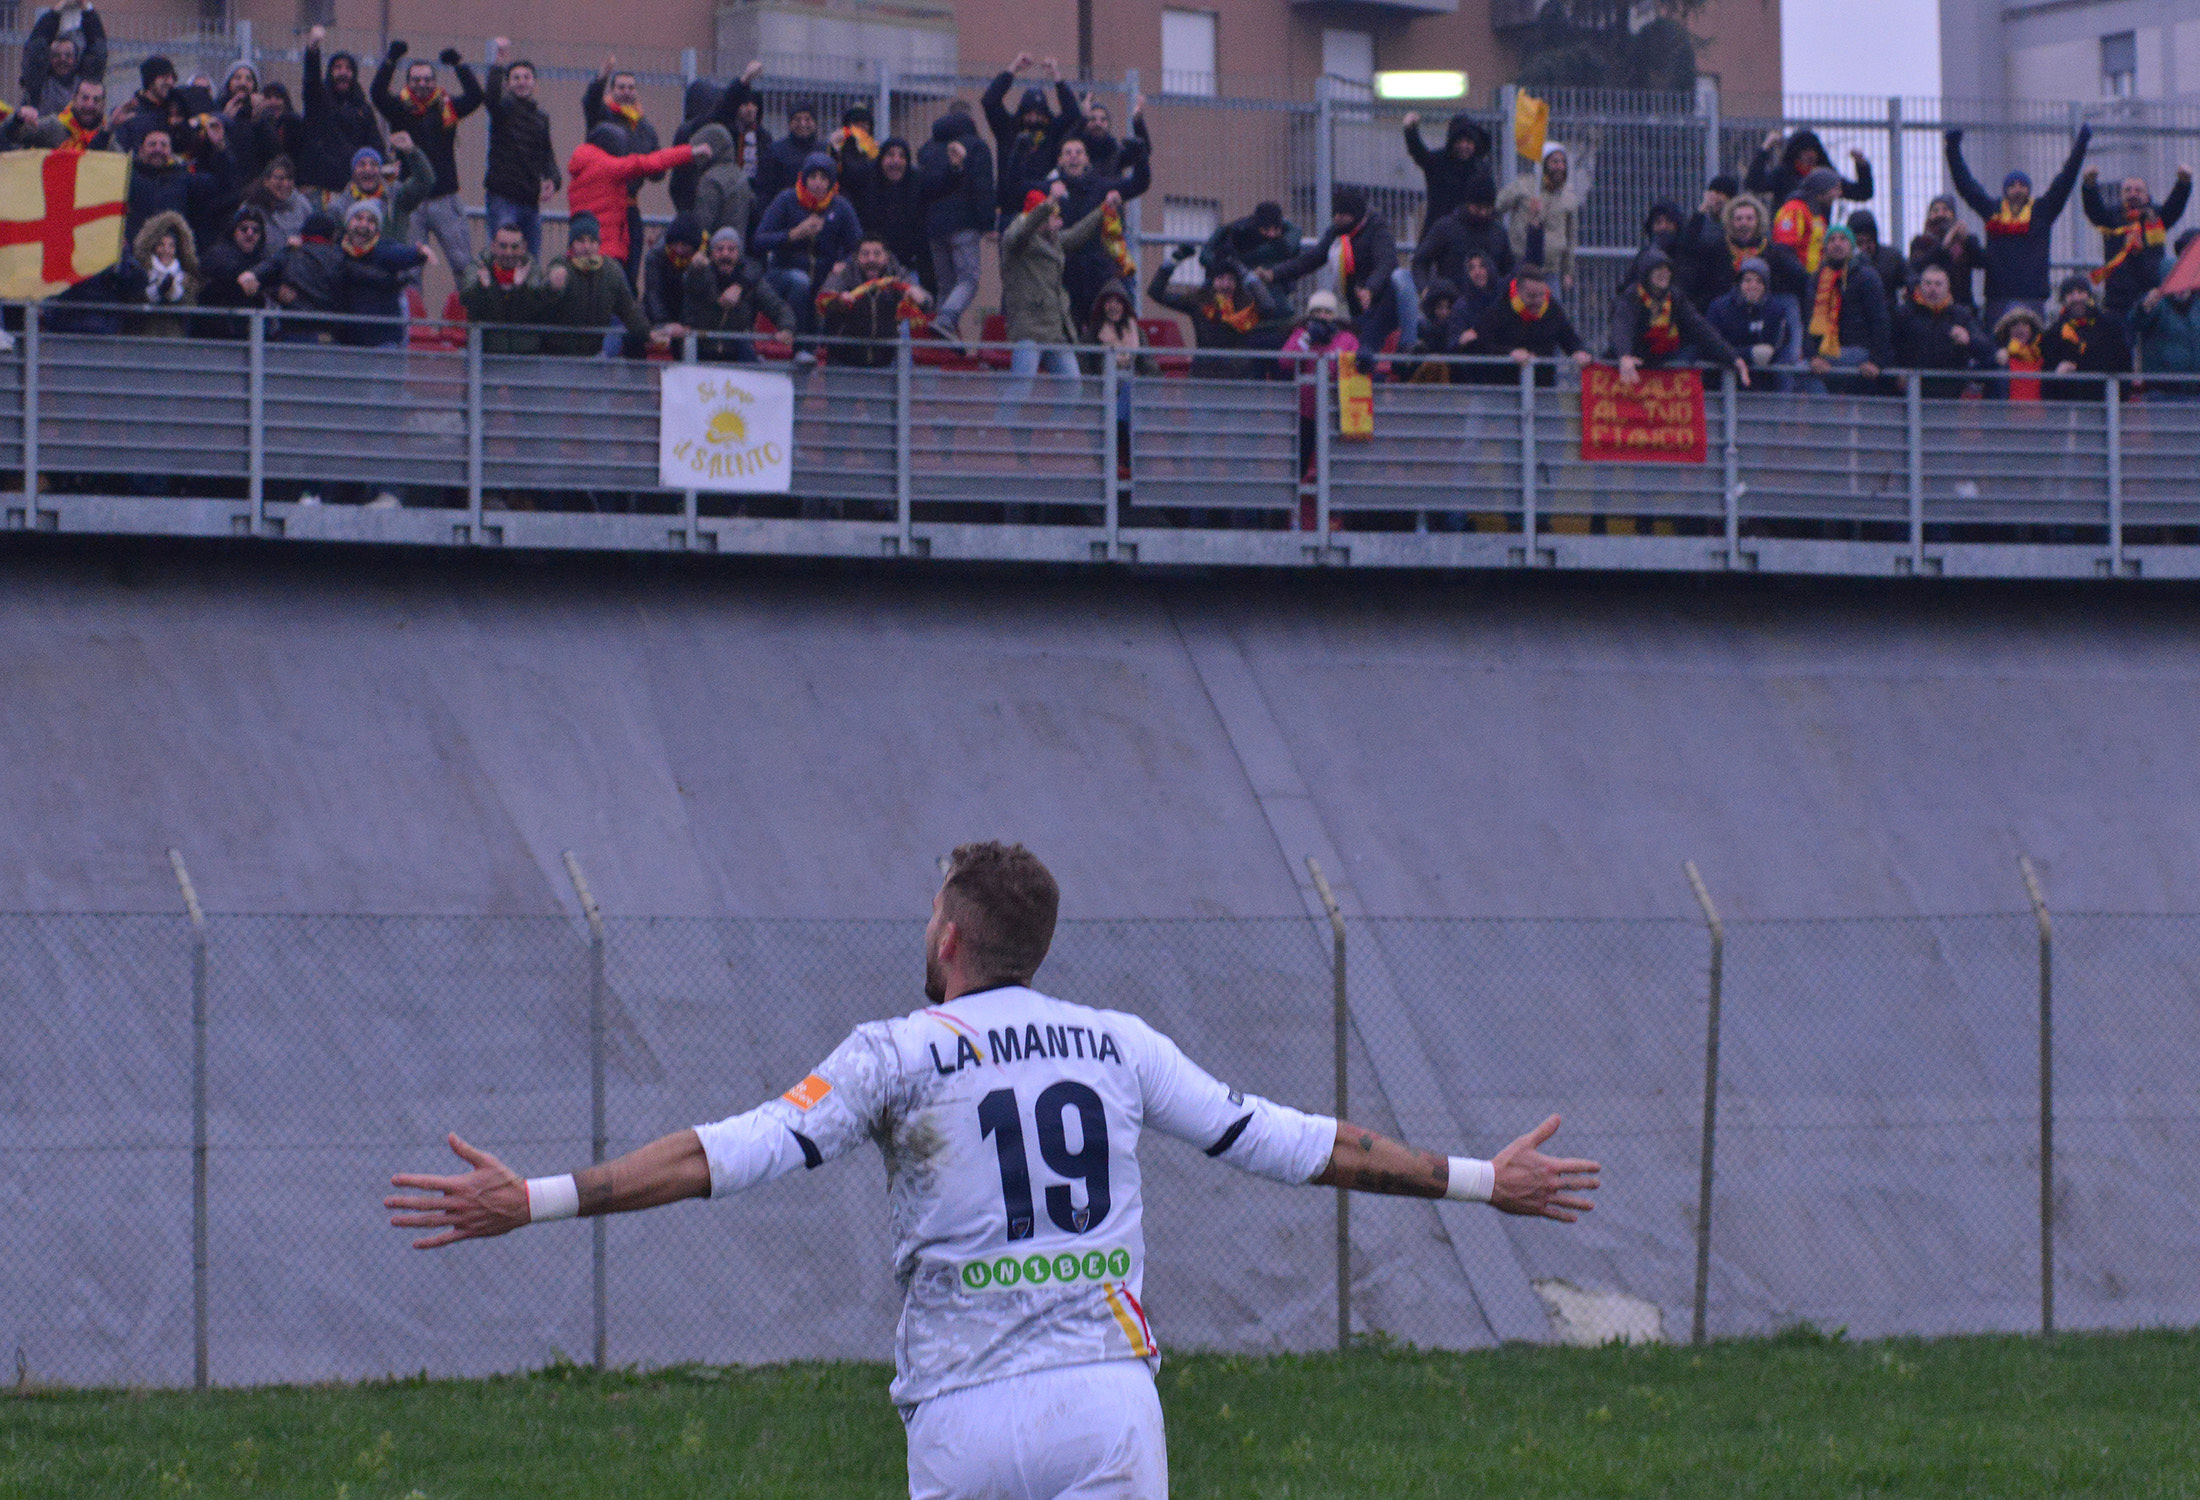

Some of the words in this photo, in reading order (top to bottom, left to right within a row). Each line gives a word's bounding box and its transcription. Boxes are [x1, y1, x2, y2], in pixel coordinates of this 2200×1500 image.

[929, 1034, 982, 1075] LA
[987, 1022, 1122, 1066] MANTIA
[977, 1079, 1112, 1242] 19
[964, 1250, 1129, 1287] UNIBET
